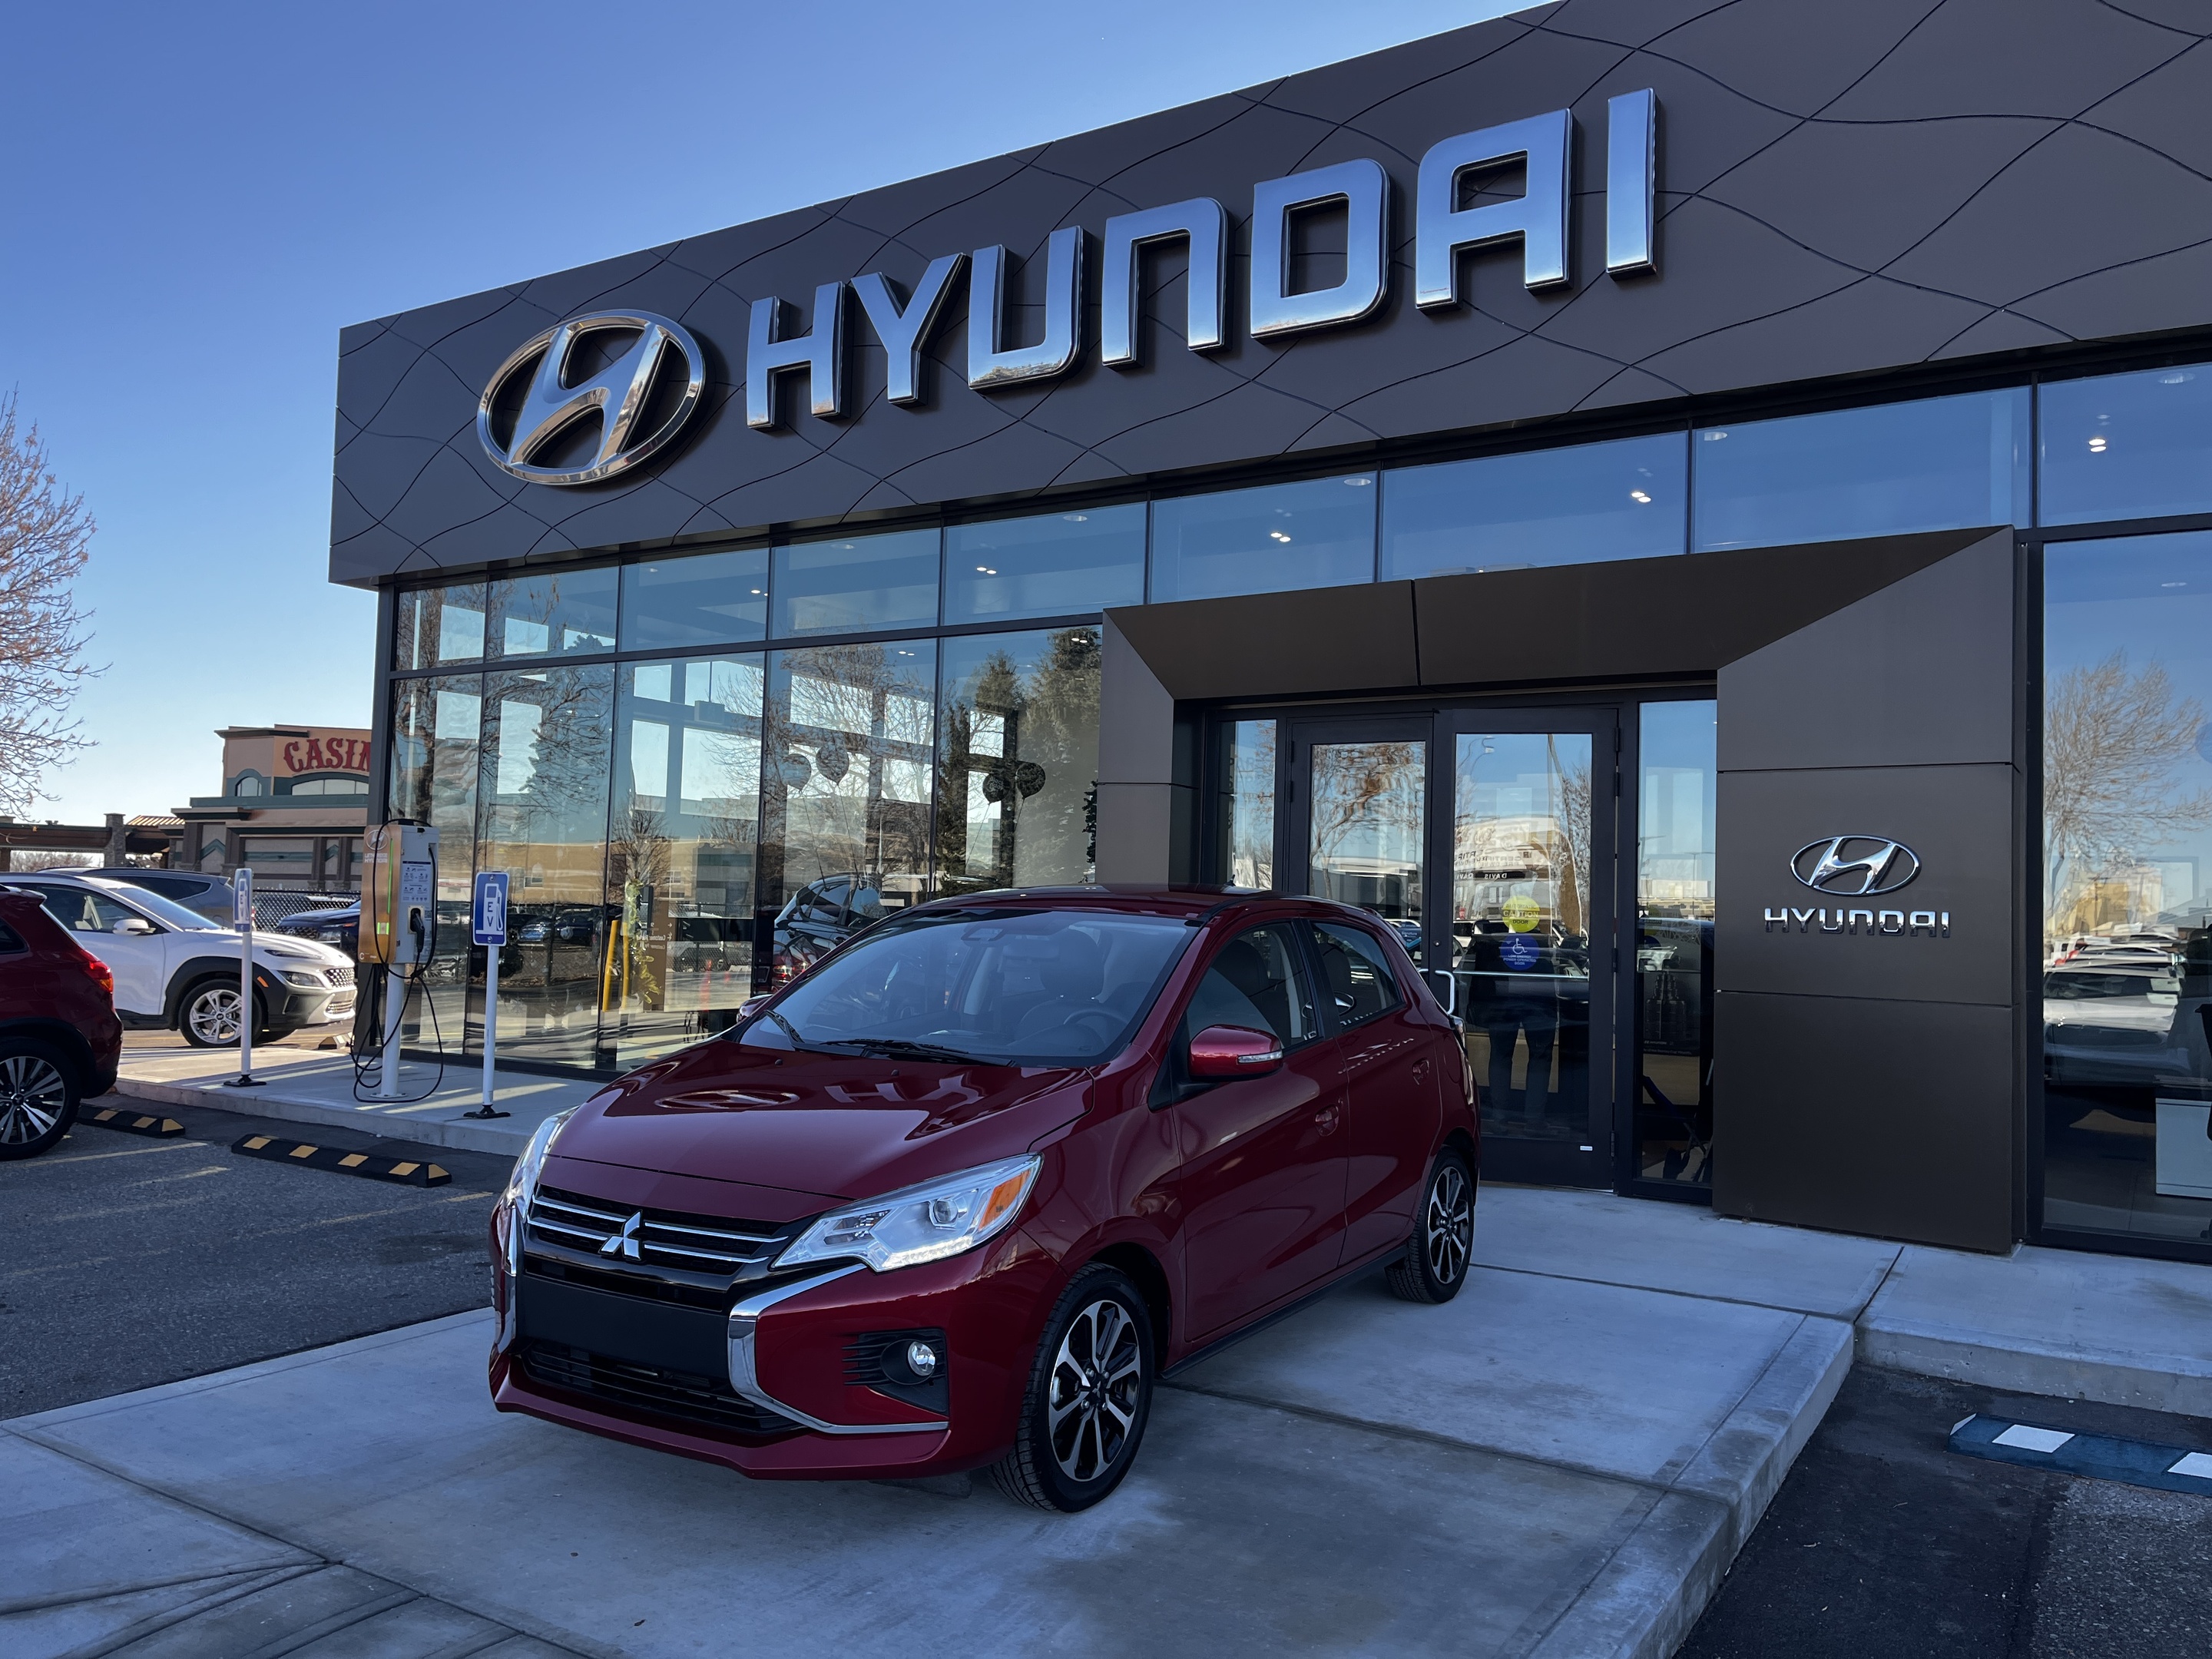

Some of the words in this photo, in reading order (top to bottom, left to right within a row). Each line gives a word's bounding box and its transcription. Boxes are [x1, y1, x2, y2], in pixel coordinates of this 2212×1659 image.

[746, 88, 1658, 430] HYUNDAI
[487, 902, 493, 926] EV
[1764, 908, 1950, 938] HYUNDAI
